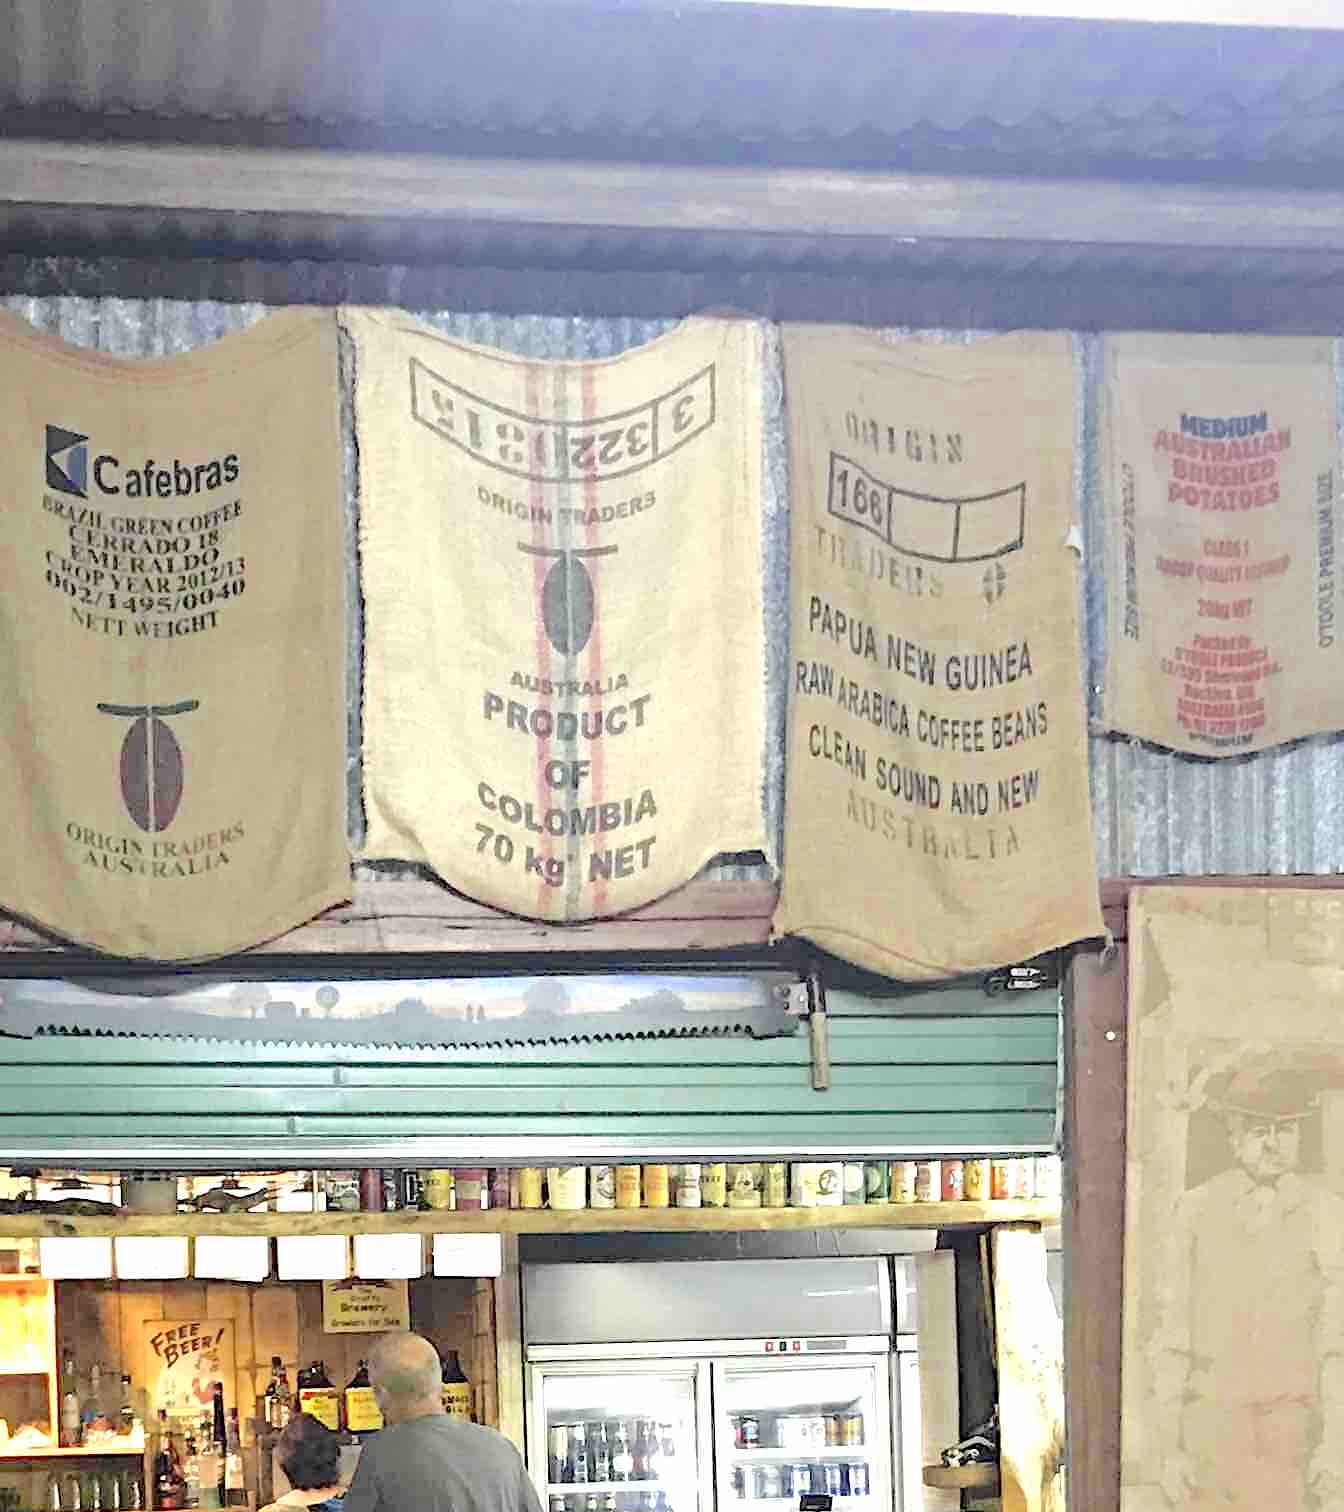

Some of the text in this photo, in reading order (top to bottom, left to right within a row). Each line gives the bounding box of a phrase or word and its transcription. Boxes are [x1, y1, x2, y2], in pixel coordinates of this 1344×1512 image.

[1181, 411, 1267, 439] MEDIUM
[1154, 427, 1291, 462] AUSTRALIAN
[93, 454, 240, 497] Cafebras
[1172, 458, 1277, 487] BRUSHED
[42, 494, 242, 535] BRAZIL GREEN COFFEE
[477, 487, 655, 525] ORIGIN TRADERS
[1168, 481, 1280, 511] POTATOES
[69, 525, 220, 555] CERRADO 18
[1319, 508, 1335, 577] PREMIUM
[46, 550, 105, 586] CROP
[112, 574, 171, 593] YEAR
[72, 607, 220, 638] NETT WEIGHT
[809, 596, 1033, 691] PAPUA NEW GUINEA
[510, 670, 629, 696] AUSTRALIA
[483, 691, 652, 741] PRODUCT
[795, 660, 1049, 752] RAW ARABICA COFFEE BEANS
[545, 760, 592, 789] OF
[809, 724, 1040, 816] CLEAN SOUND AND NEW
[477, 781, 657, 836] COLOMBIA
[66, 820, 245, 857] ORIGIN TRADERS
[475, 822, 514, 864] 70
[589, 835, 657, 882] NET
[85, 850, 229, 877] AUSTRALIA
[150, 1323, 201, 1357] FREE
[163, 1328, 225, 1368] BEER!
